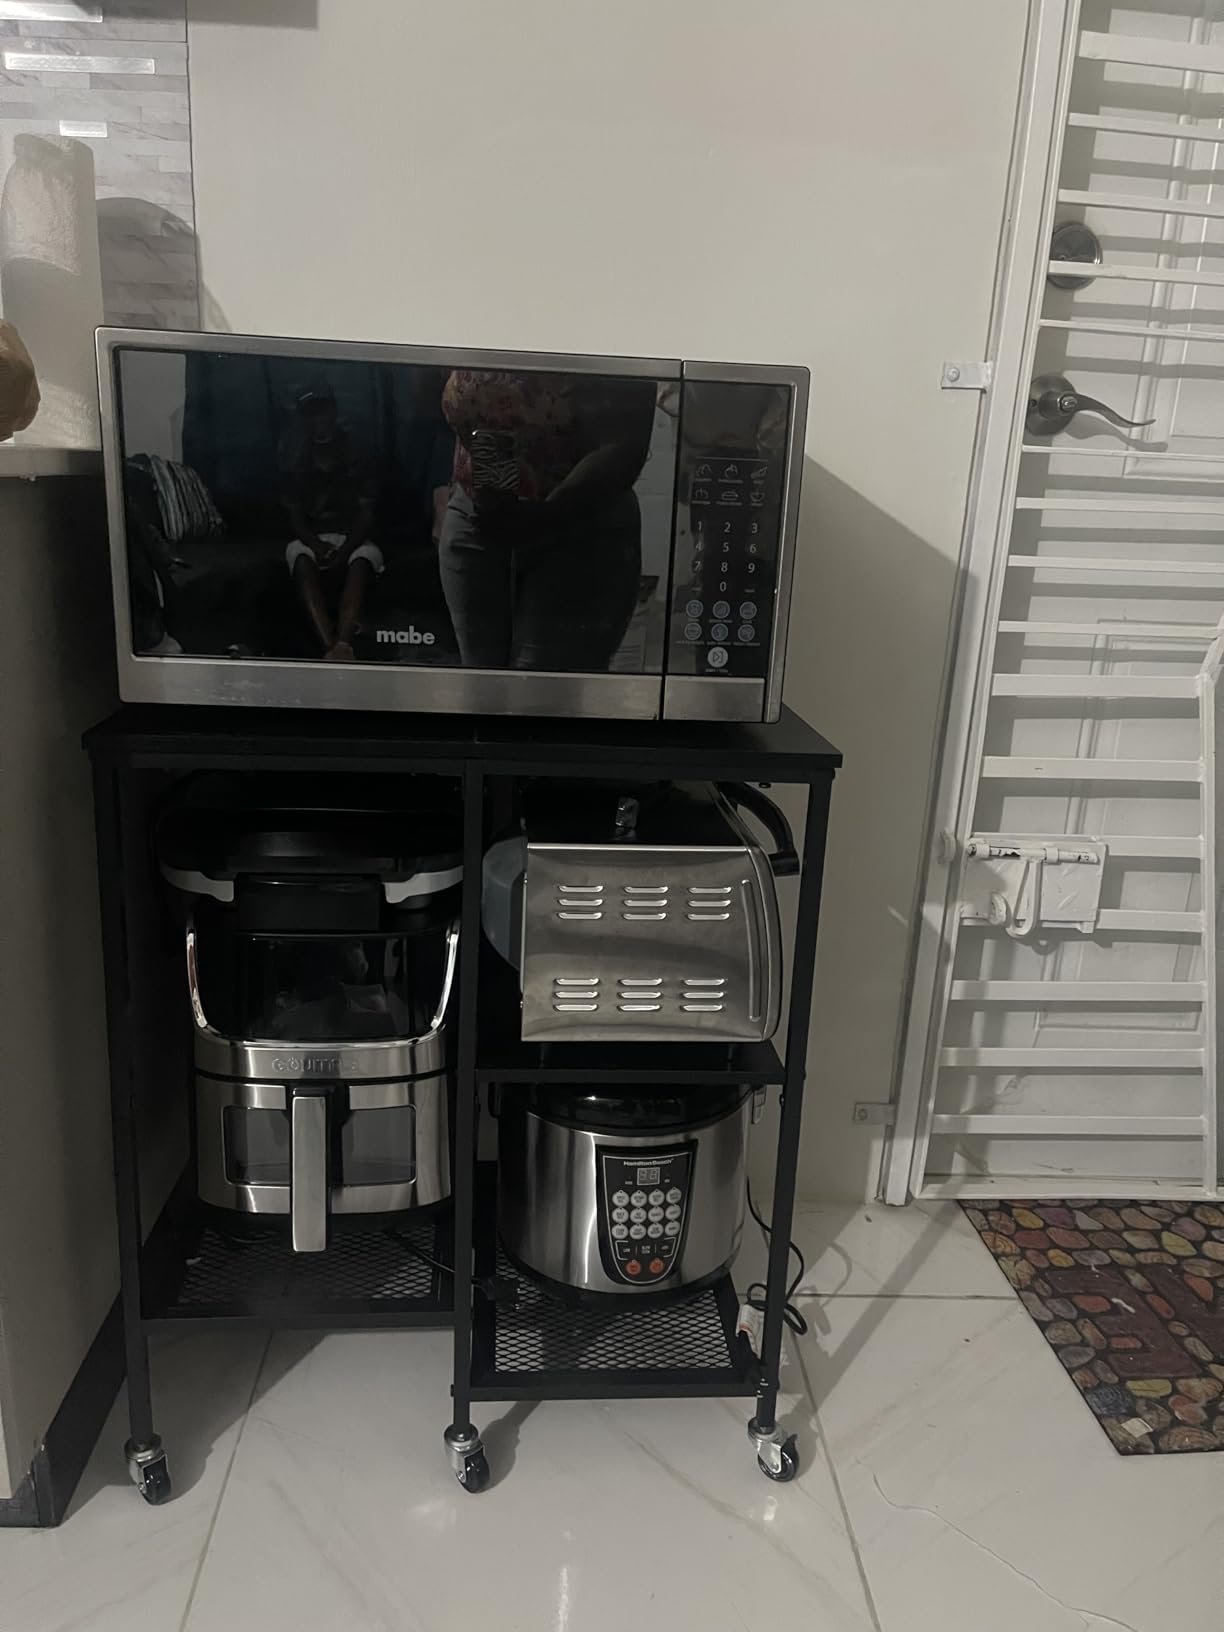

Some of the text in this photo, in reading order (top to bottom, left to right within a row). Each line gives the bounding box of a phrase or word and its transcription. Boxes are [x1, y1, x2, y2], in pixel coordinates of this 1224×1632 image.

[697, 521, 758, 534] 1 2 3
[695, 542, 757, 554] 4 5 6
[694, 561, 755, 574] 7 8 9
[719, 582, 727, 592] 0
[376, 625, 435, 645] mabe
